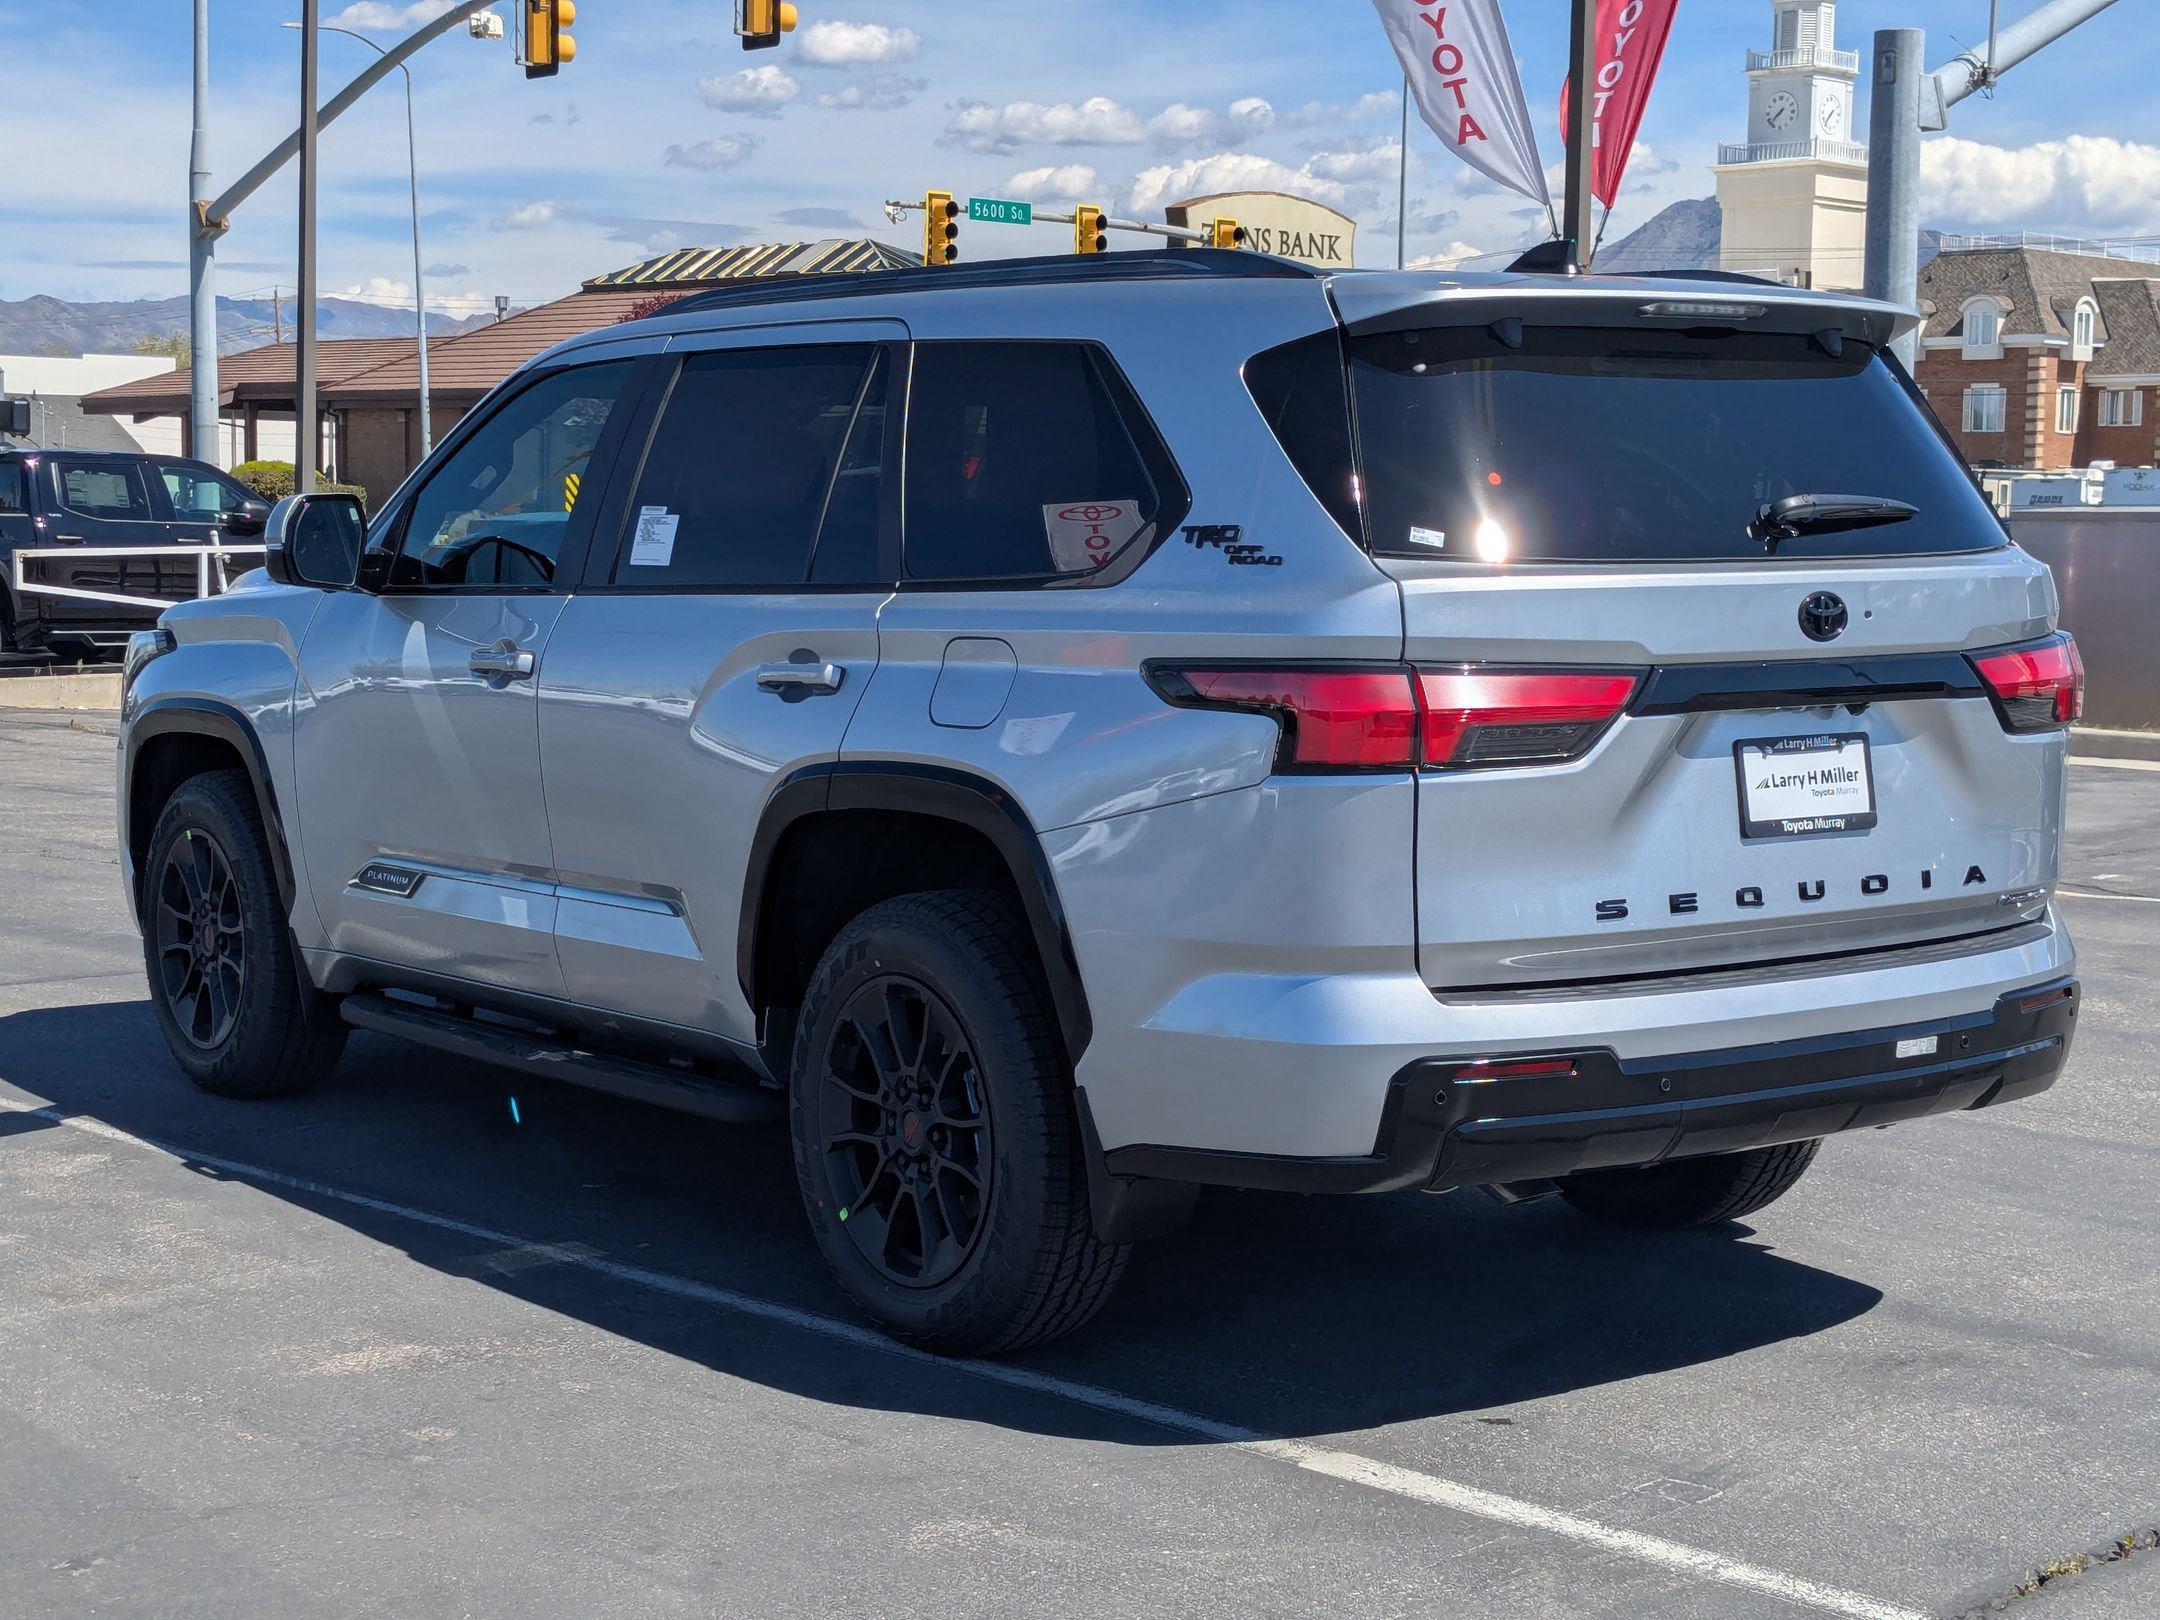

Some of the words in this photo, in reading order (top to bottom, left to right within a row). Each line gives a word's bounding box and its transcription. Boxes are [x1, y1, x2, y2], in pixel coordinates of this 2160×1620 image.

[1414, 0, 1488, 145] YOTA
[975, 202, 1005, 218] 5600
[1201, 222, 1272, 254] ZNS
[1278, 230, 1342, 261] BANK
[1180, 525, 1242, 549] TRD
[1223, 545, 1264, 555] OFF
[1228, 555, 1283, 566] ROAD
[1784, 738, 1806, 750] Larry
[1807, 738, 1814, 748] H
[1814, 735, 1838, 747] Miller
[1771, 773, 1806, 790] Larry
[1808, 770, 1817, 785] H
[1821, 766, 1859, 784] Miller
[1811, 788, 1835, 798] Toyota
[1836, 787, 1859, 796] Murray
[1782, 820, 1814, 833] Toyota
[1814, 818, 1845, 830] Murray
[367, 870, 409, 885] PLATINUM
[1595, 865, 1986, 920] SEQUOIA
